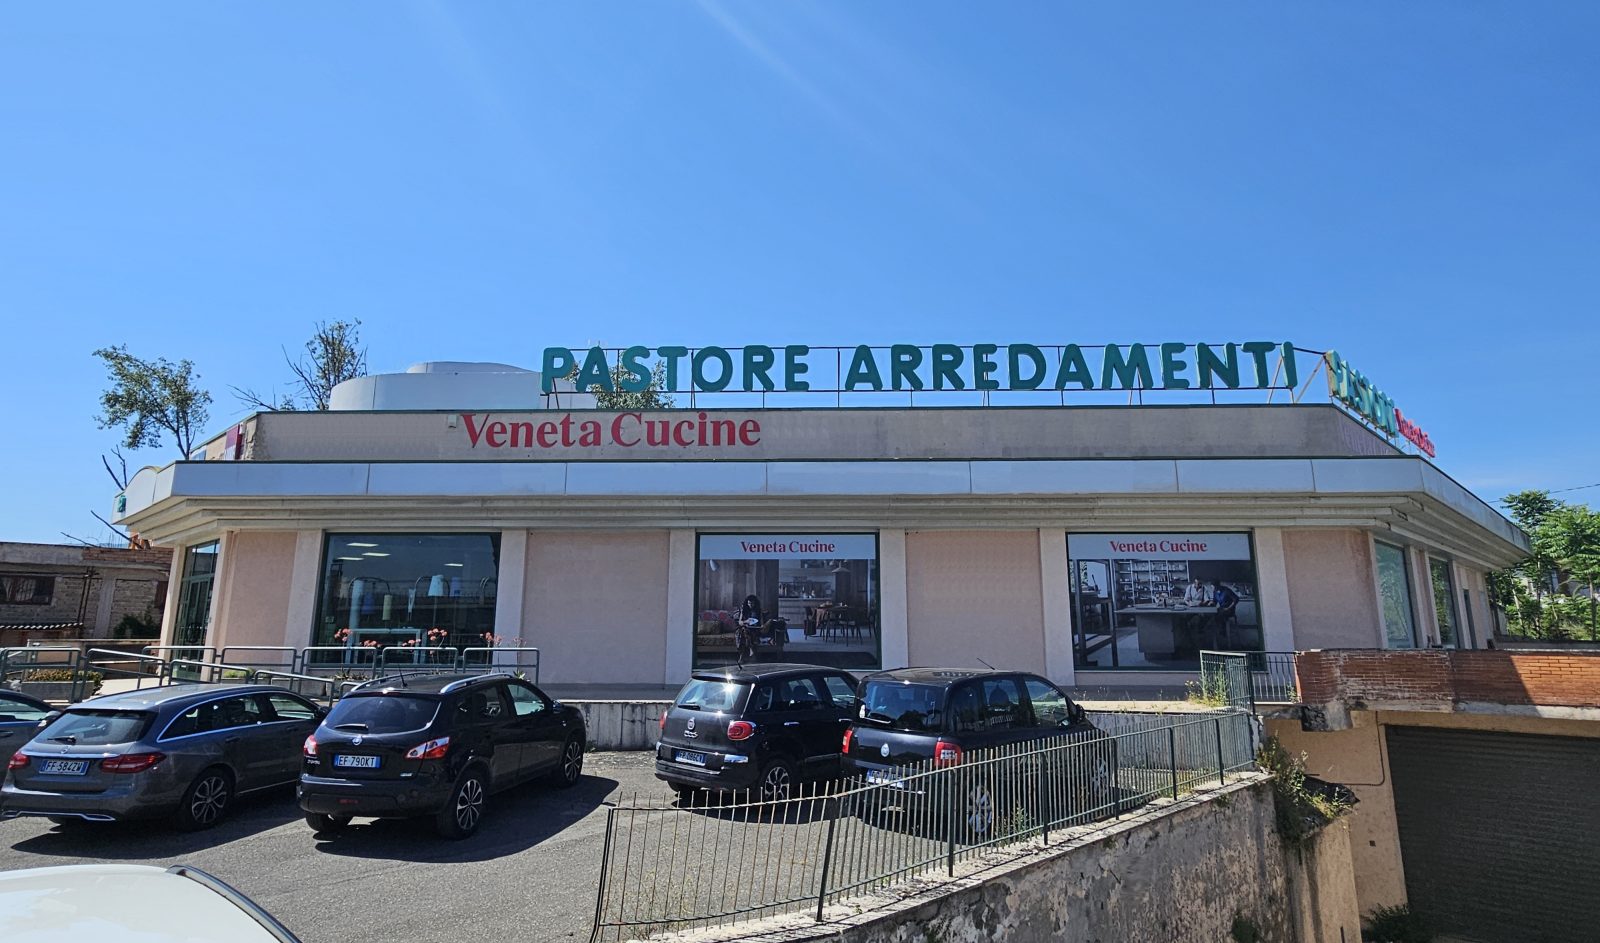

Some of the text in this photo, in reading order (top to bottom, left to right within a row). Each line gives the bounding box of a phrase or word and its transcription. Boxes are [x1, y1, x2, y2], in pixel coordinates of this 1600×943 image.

[541, 340, 1298, 394] PASTORE ARREDAMENTI
[460, 411, 761, 449] Veneta Cucine
[741, 540, 835, 553] Veneta Cucine
[1110, 539, 1208, 553] Veneta Cucine
[339, 756, 375, 767] EF 790KT
